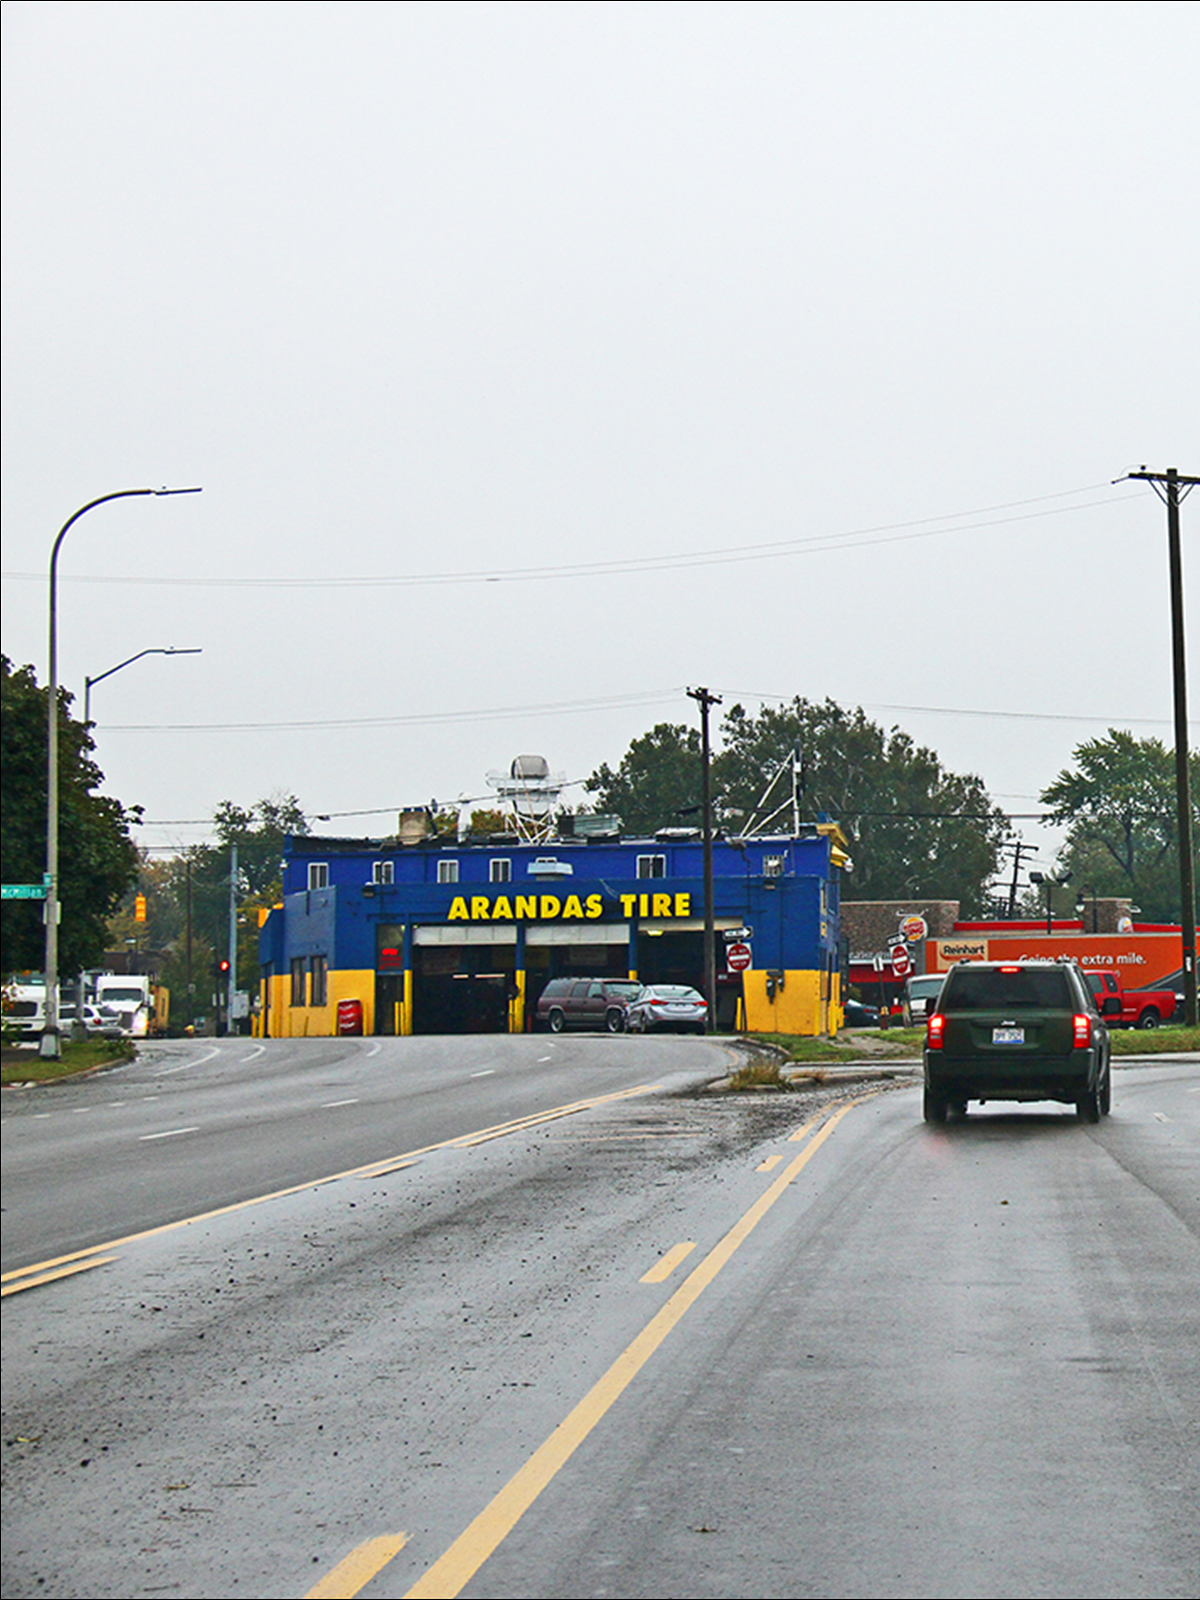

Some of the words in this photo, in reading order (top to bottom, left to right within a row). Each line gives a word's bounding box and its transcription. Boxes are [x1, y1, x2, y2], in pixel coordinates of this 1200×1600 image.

[447, 893, 604, 920] ARANDAS
[620, 893, 690, 918] TIRE
[943, 945, 985, 955] Reinhart
[1082, 955, 1113, 965] extra
[1117, 953, 1147, 965] mile.
